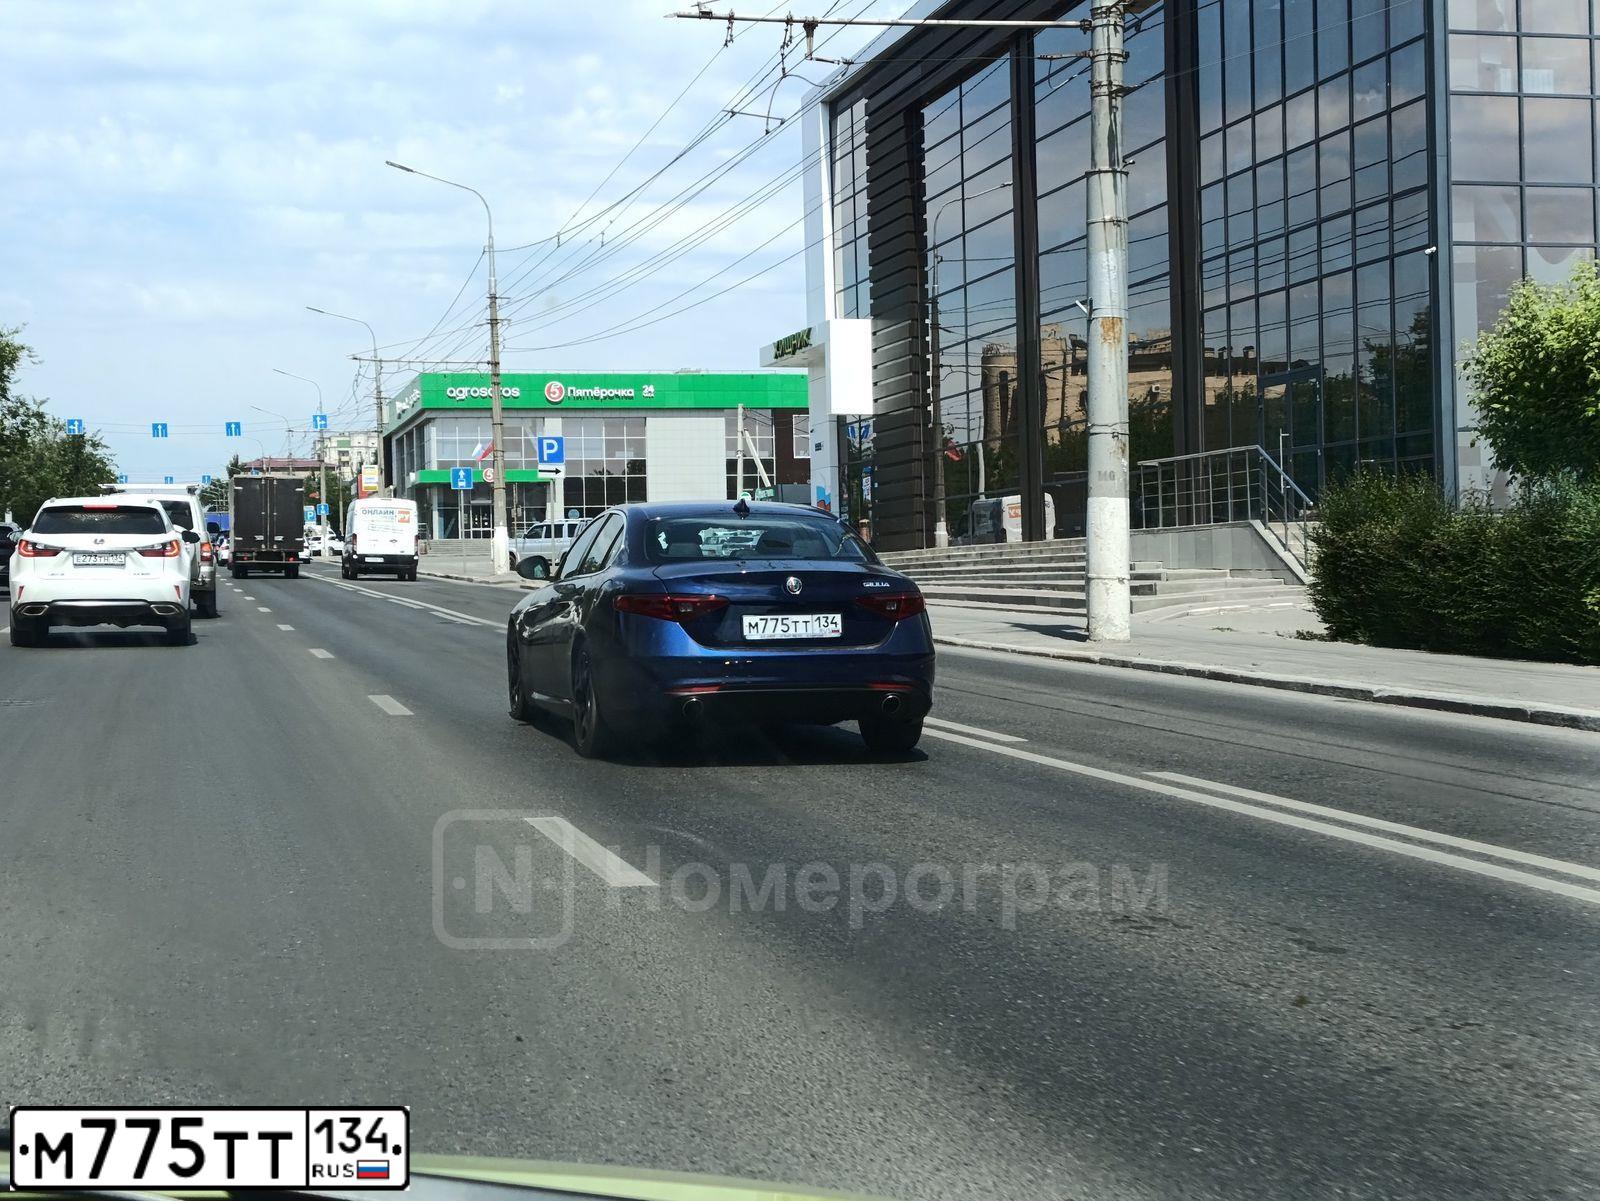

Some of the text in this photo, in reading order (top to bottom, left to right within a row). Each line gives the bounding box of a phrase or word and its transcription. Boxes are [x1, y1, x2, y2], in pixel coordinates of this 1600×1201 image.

[567, 385, 634, 399] Пятёрочка
[543, 439, 558, 461] P
[748, 617, 810, 634] М775ТТ
[814, 616, 838, 628] 134
